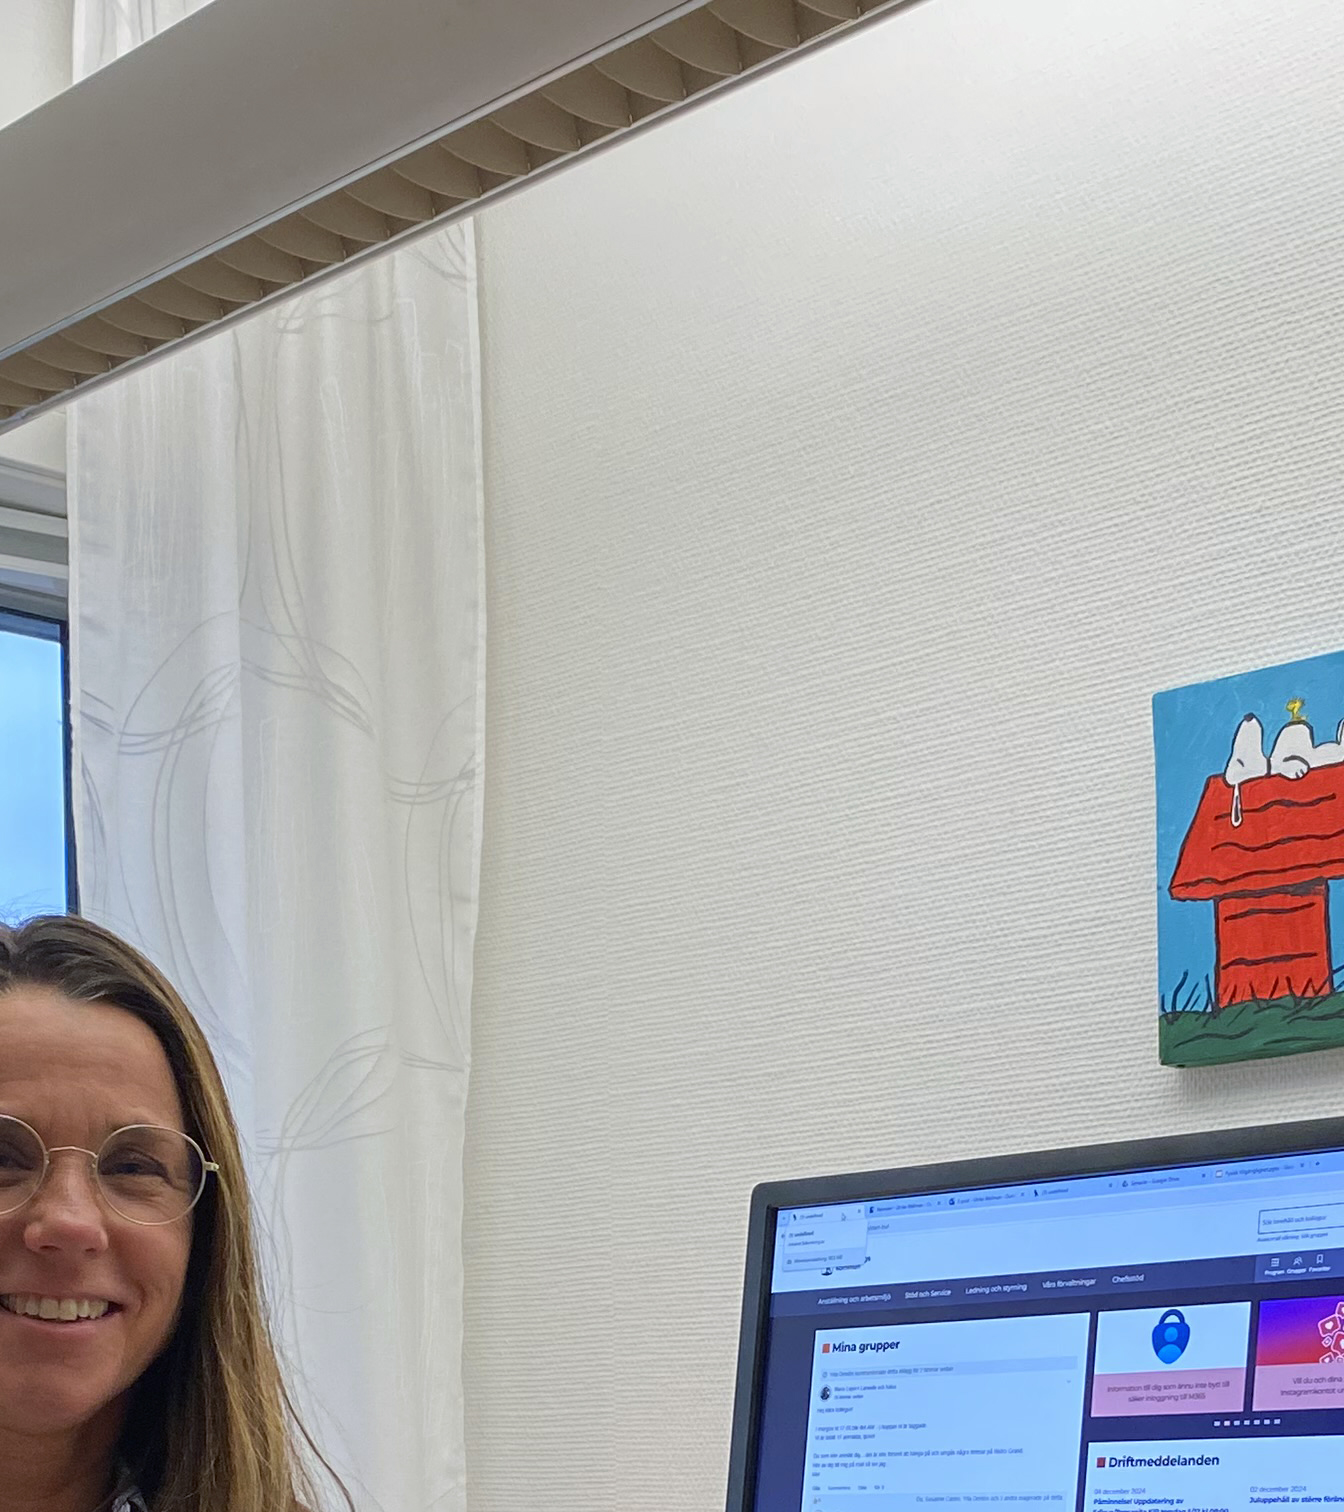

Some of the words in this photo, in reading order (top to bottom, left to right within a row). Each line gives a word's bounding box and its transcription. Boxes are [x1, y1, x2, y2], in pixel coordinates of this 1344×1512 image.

[965, 1286, 990, 1296] Ledning
[991, 1285, 1002, 1293] och
[832, 1341, 856, 1353] Mina
[858, 1341, 901, 1354] grupper
[1313, 1376, 1327, 1384] och
[1107, 1385, 1143, 1393] Information
[1151, 1384, 1162, 1392] dig
[1108, 1455, 1220, 1468] Driftmeddelanden
[1131, 1487, 1146, 1495] 2024
[1133, 1498, 1174, 1506] Uppdatering
[1301, 1495, 1322, 1503] större
